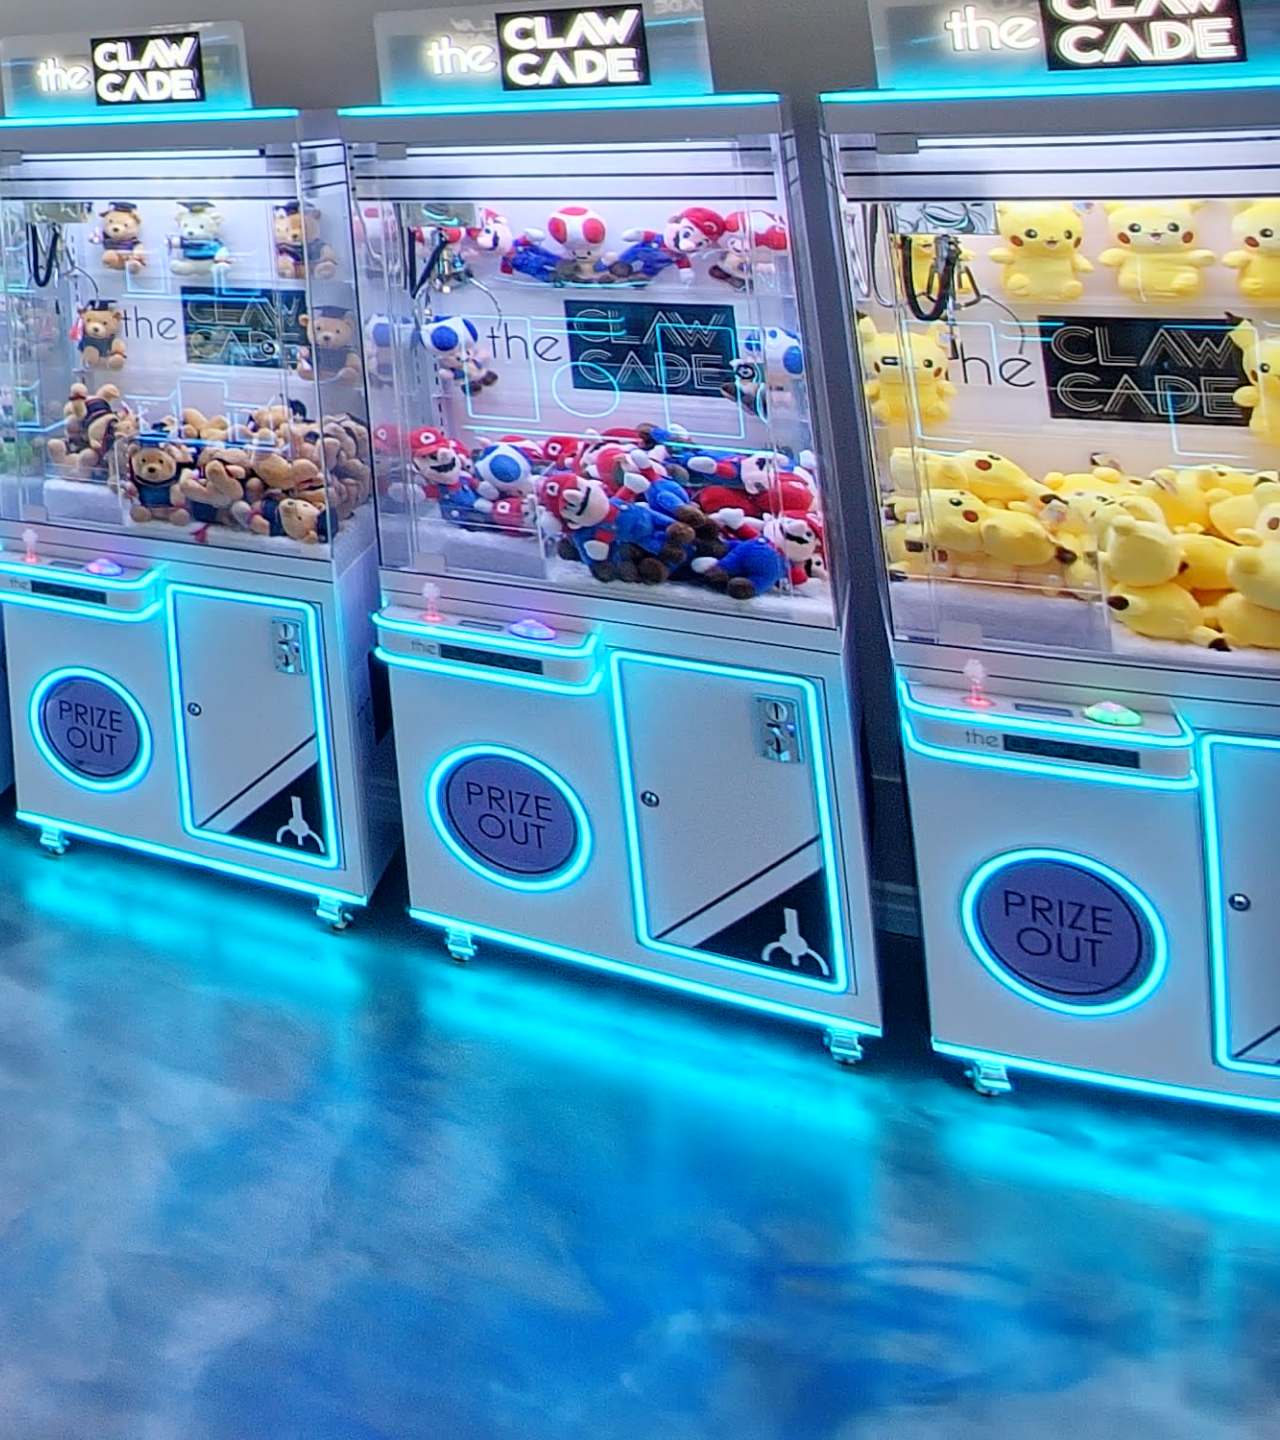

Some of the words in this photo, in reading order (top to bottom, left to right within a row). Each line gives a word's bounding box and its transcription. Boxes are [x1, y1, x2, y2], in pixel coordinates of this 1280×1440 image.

[502, 9, 640, 51] CLAW
[945, 6, 1040, 51] the
[1057, 17, 1237, 64] CADE
[93, 36, 198, 71] CLAW
[427, 36, 498, 75] the
[505, 47, 640, 86] CADE
[37, 57, 92, 92] the
[96, 69, 198, 103] CADE
[121, 306, 178, 341] the
[486, 323, 562, 362] the
[573, 308, 726, 348] CLAW
[1050, 326, 1235, 368] CLAW
[577, 349, 725, 391] CADE
[1056, 372, 1243, 418] CADE
[58, 699, 124, 734] PRIZE
[66, 725, 119, 757] OUT
[965, 728, 999, 748] the
[465, 780, 553, 823] PRIZE
[478, 812, 547, 850] OUT
[1003, 889, 1113, 936] PRIZE
[1016, 928, 1103, 967] OUT
